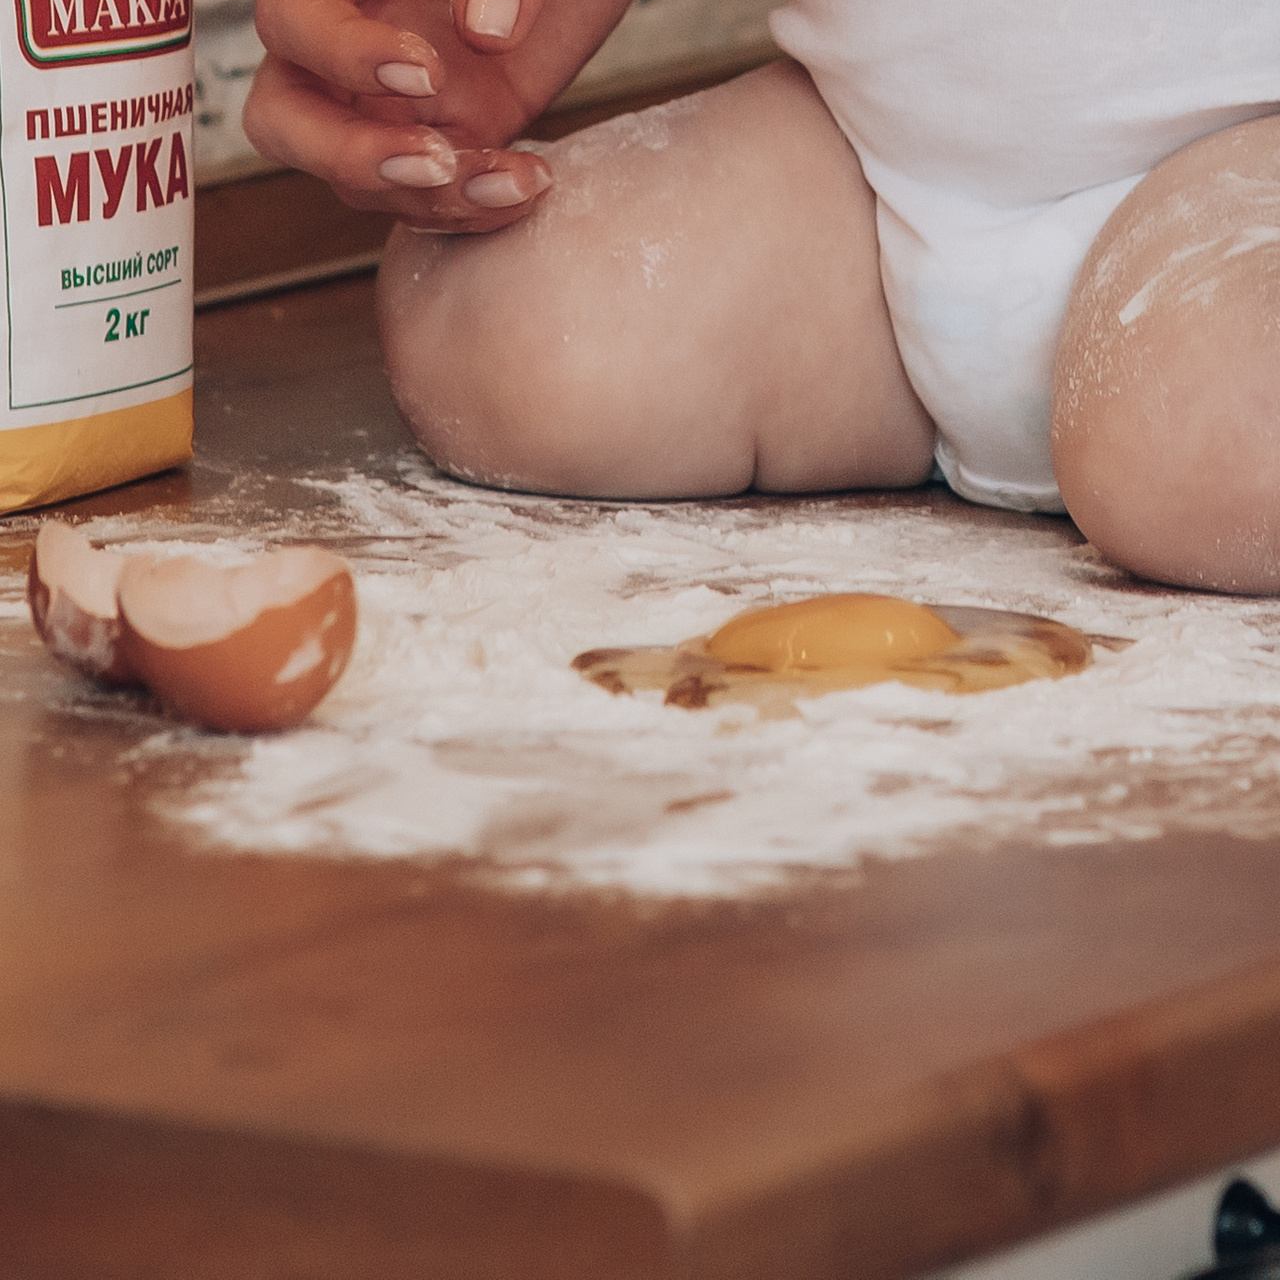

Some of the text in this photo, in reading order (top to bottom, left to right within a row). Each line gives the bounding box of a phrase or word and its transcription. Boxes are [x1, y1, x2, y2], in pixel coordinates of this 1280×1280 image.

[26, 82, 193, 141] ПШЕНИЧНАЯ
[34, 131, 189, 227] МУКА
[61, 245, 179, 290] ВЫСШИЙ СОРТ
[104, 308, 121, 343] 2
